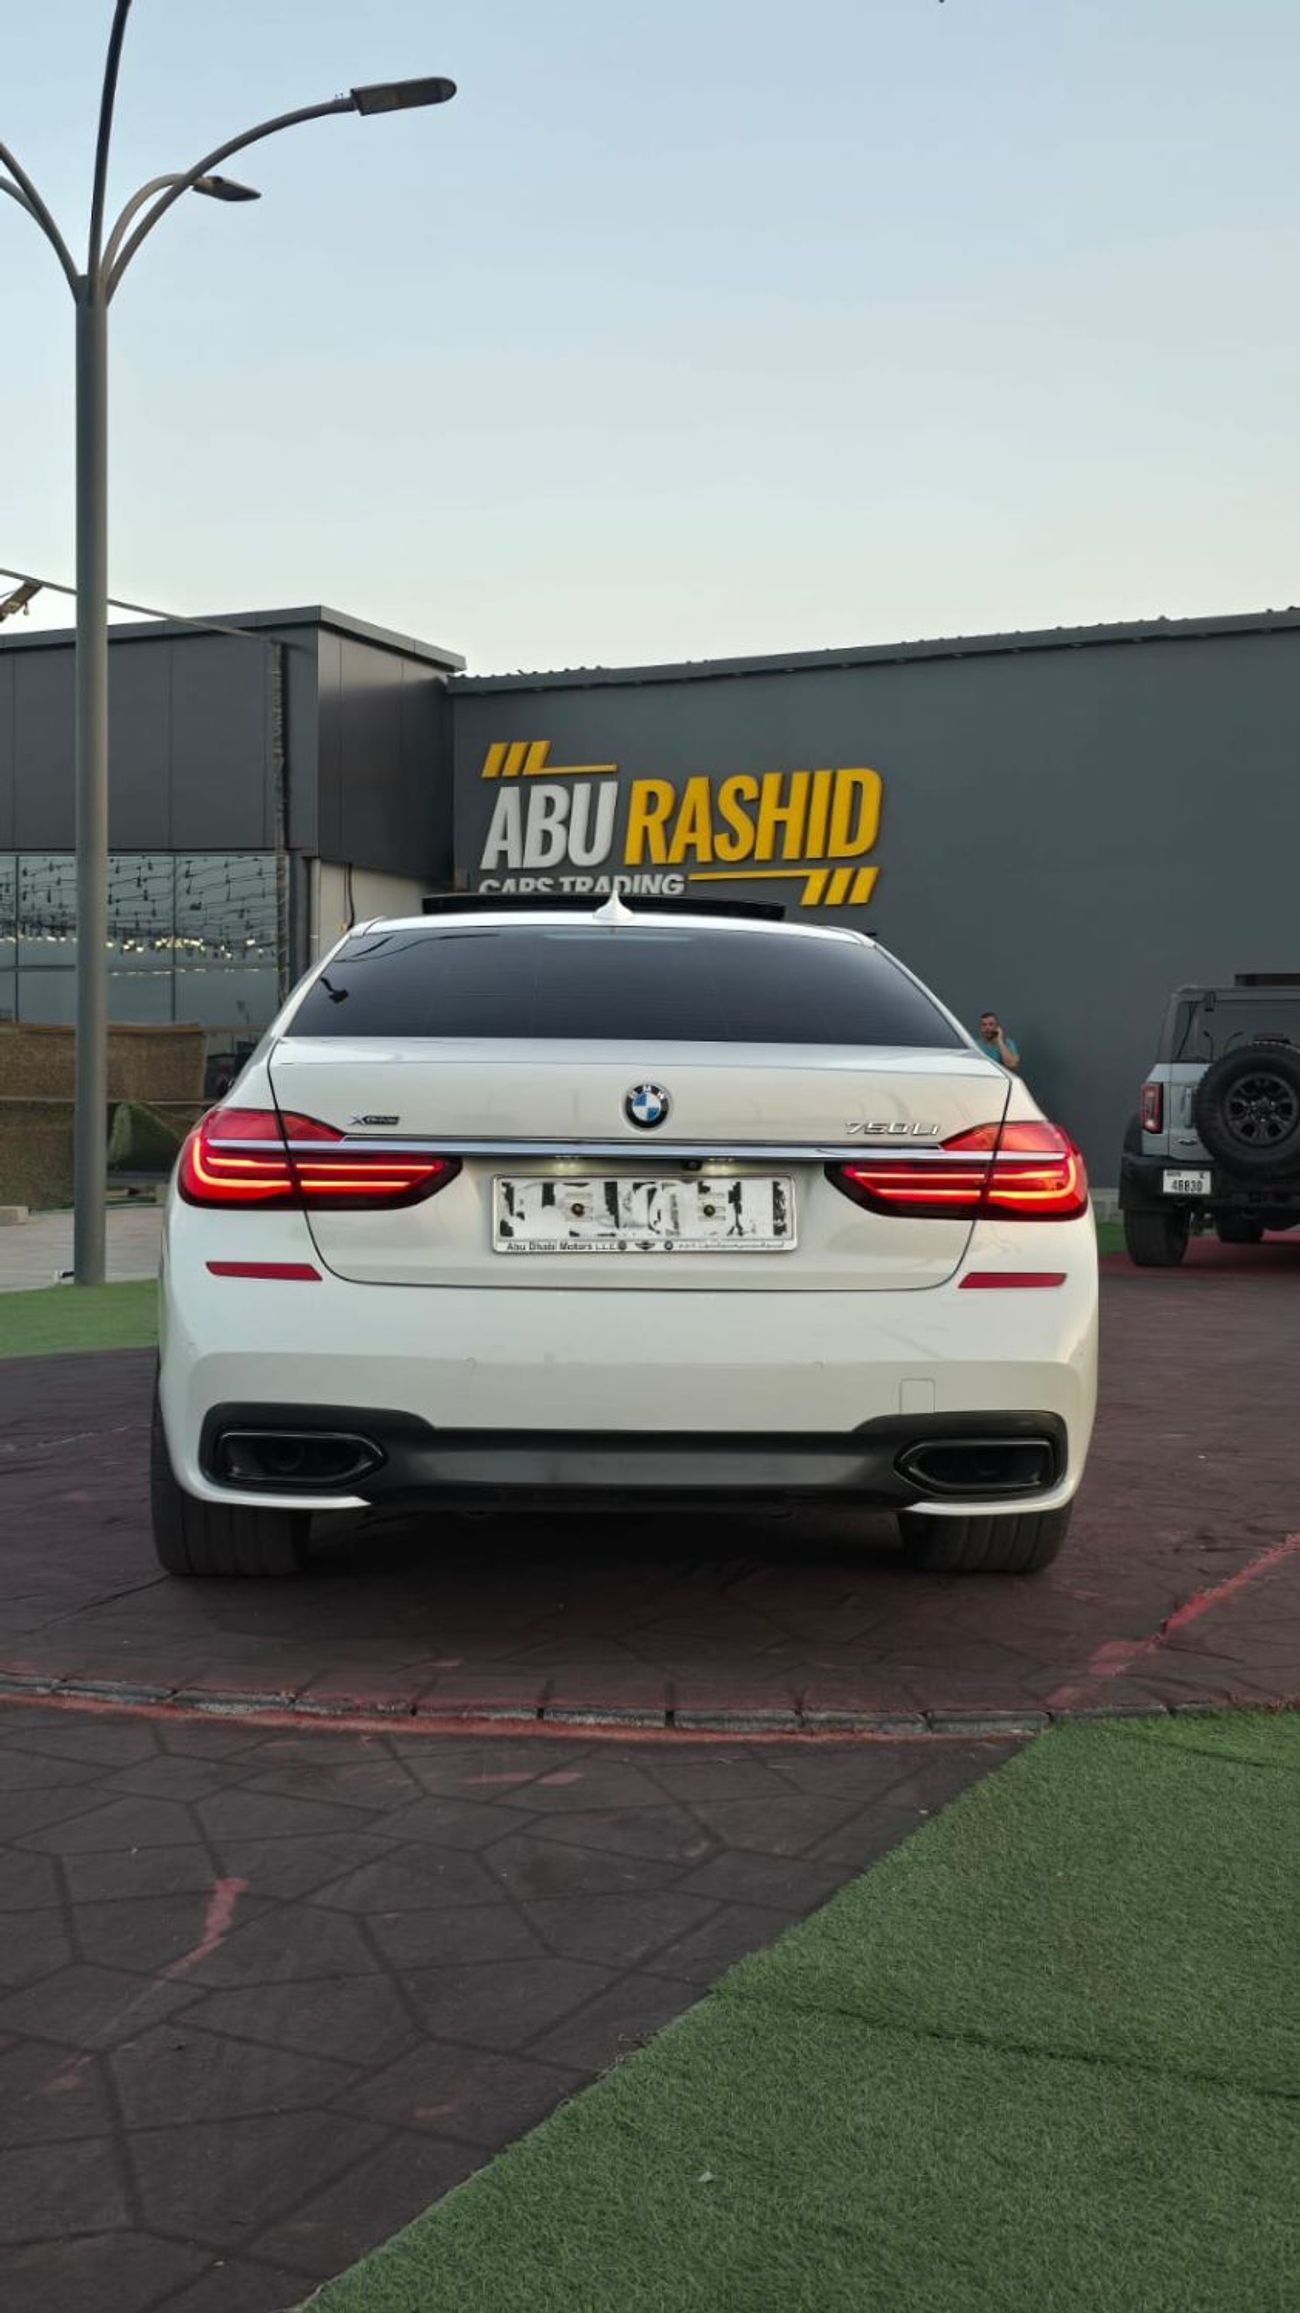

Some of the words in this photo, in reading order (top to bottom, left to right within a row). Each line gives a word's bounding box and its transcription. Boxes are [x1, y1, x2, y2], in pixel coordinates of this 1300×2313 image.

[480, 782, 618, 870] ABU
[624, 768, 881, 866] RASHID
[559, 874, 685, 895] TRADING
[506, 1241, 526, 1250] Abu
[559, 1241, 593, 1250] Motors
